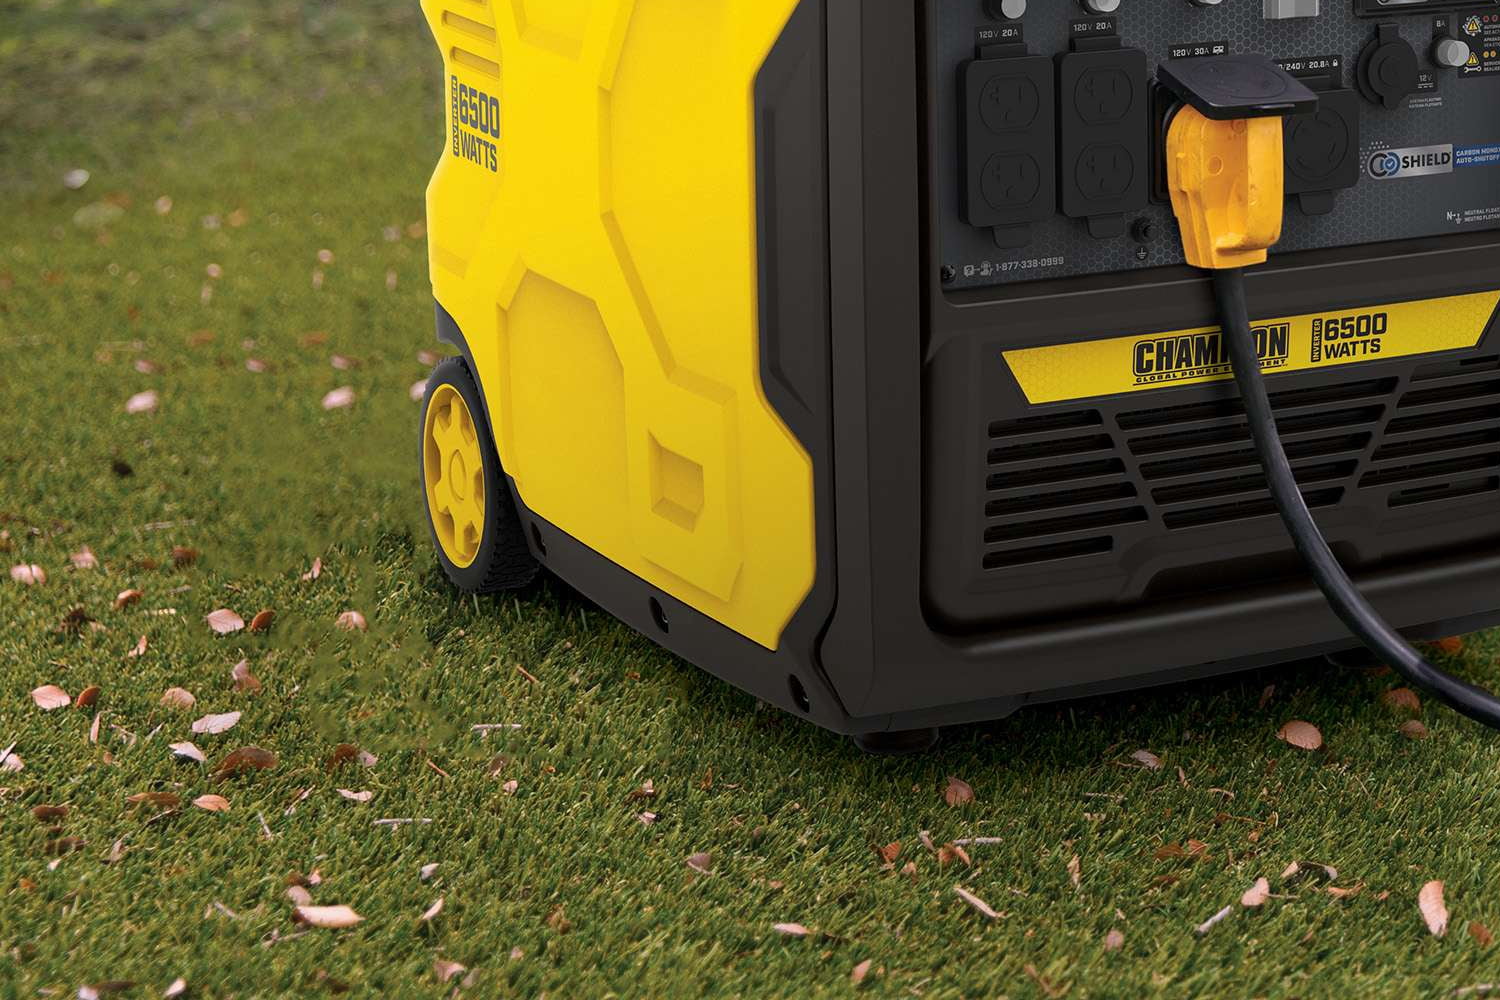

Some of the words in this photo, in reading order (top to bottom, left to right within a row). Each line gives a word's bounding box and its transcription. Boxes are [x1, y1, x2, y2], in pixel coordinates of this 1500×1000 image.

[451, 75, 459, 157] INVERTER
[459, 83, 500, 139] 6500
[460, 129, 497, 172] WATTS
[1402, 151, 1450, 169] SHIELD
[1456, 149, 1480, 157] CARBON
[1312, 319, 1321, 361] INVERTER
[1324, 312, 1387, 341] 6500
[1324, 338, 1381, 359] WATTS
[1136, 372, 1178, 383] GLOBAL
[1180, 366, 1218, 378] POWER
